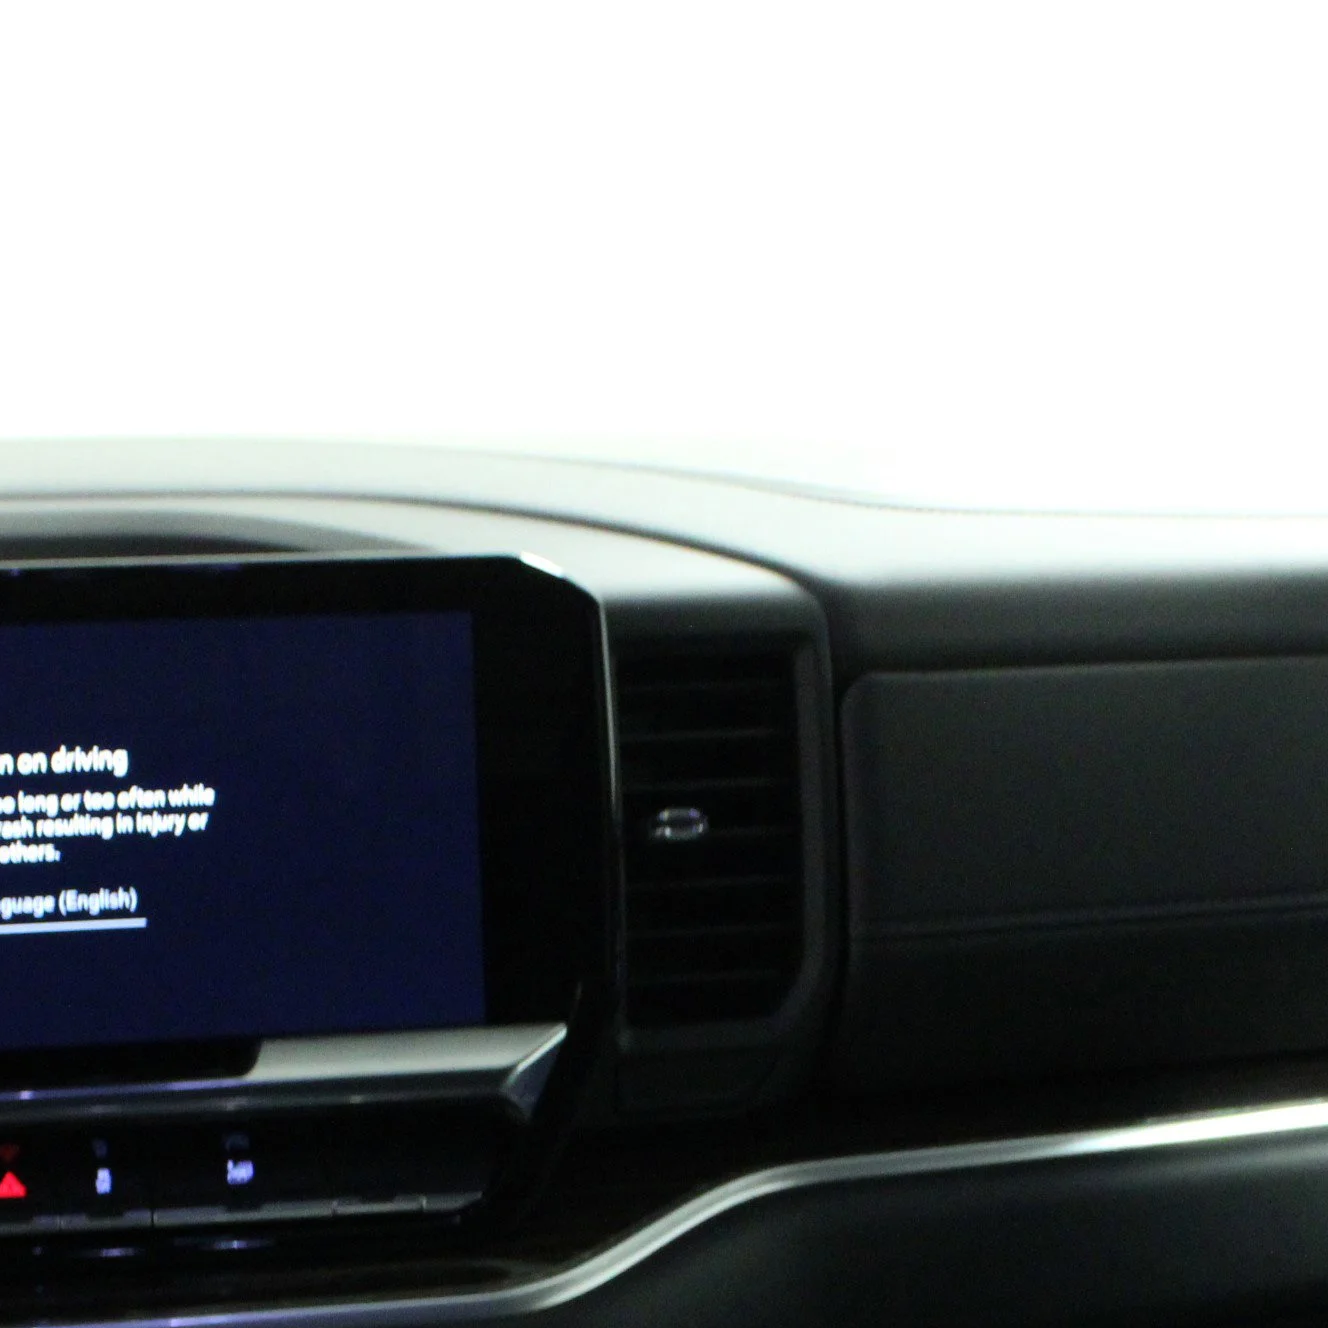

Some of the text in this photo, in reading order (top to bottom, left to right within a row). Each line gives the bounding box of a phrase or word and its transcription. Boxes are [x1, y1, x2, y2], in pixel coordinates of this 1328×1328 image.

[17, 753, 47, 775] on
[51, 745, 128, 777] driving
[18, 790, 58, 817] long
[60, 793, 82, 812] or
[83, 790, 115, 810] too
[117, 785, 166, 809] often
[168, 783, 215, 807] while
[36, 813, 113, 839] resulting
[116, 812, 134, 834] in
[136, 811, 186, 837] injury
[187, 812, 209, 830] or
[59, 886, 138, 917] (English)
